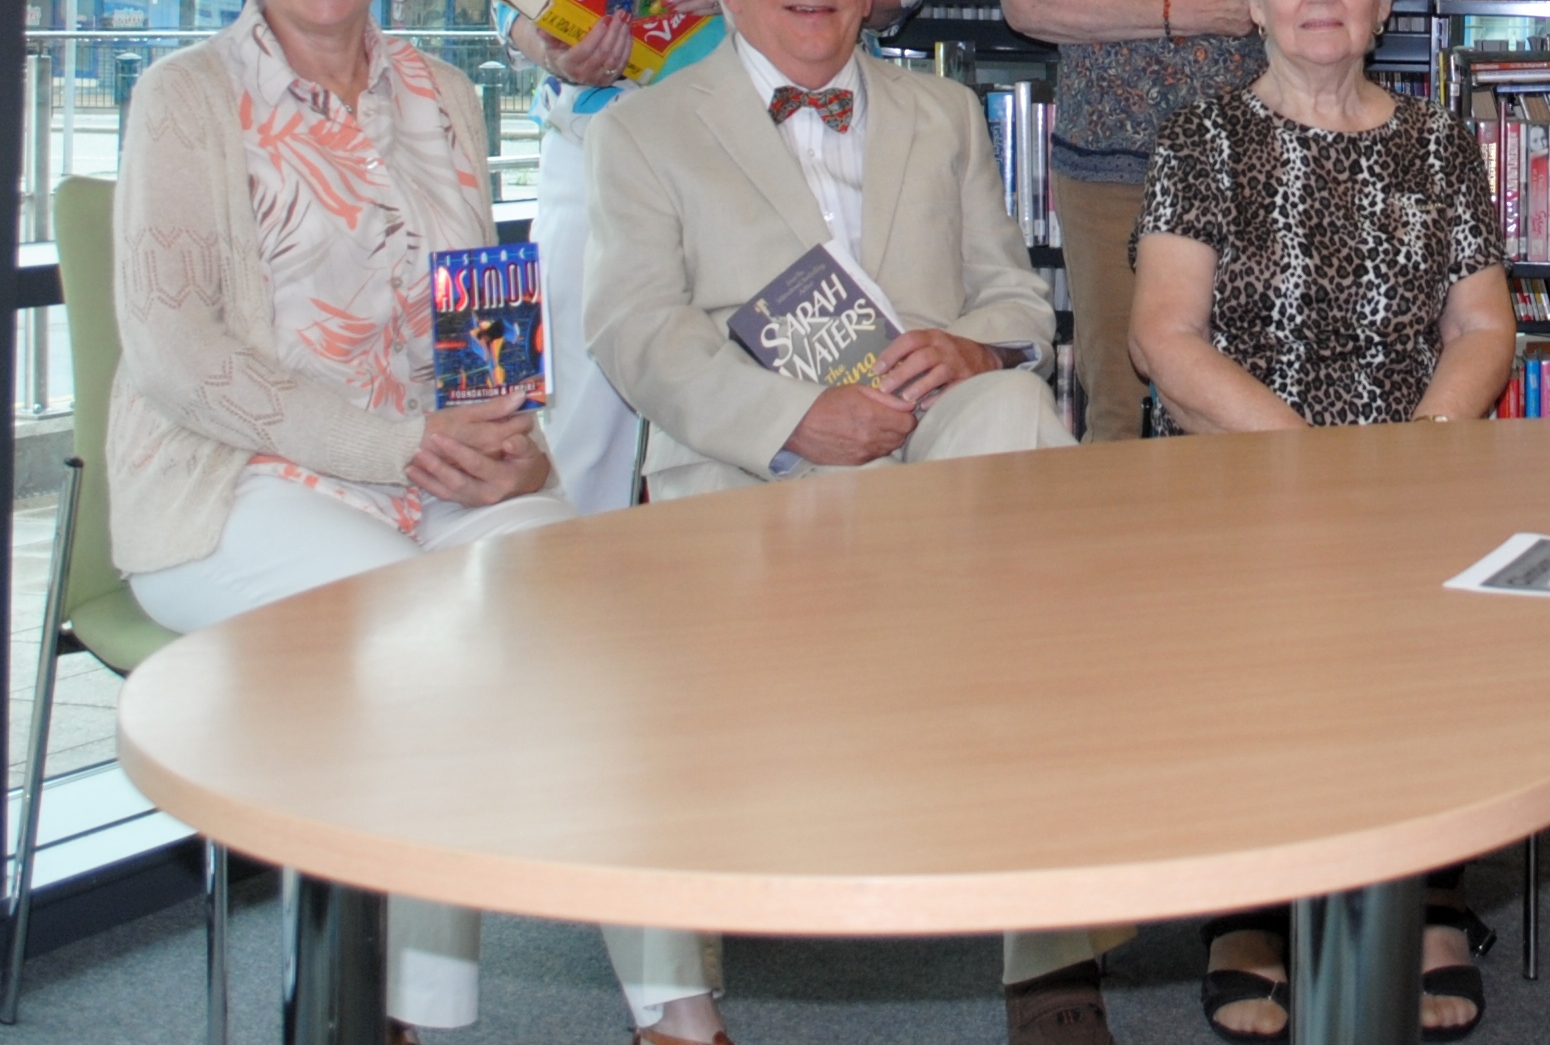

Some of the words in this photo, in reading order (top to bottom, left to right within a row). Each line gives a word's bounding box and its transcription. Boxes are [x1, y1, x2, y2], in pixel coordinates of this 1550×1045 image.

[447, 248, 525, 266] ISAAC
[435, 260, 539, 312] ASIMOV
[760, 272, 848, 367] SARAH
[778, 298, 877, 383] WATERS
[824, 364, 847, 384] The
